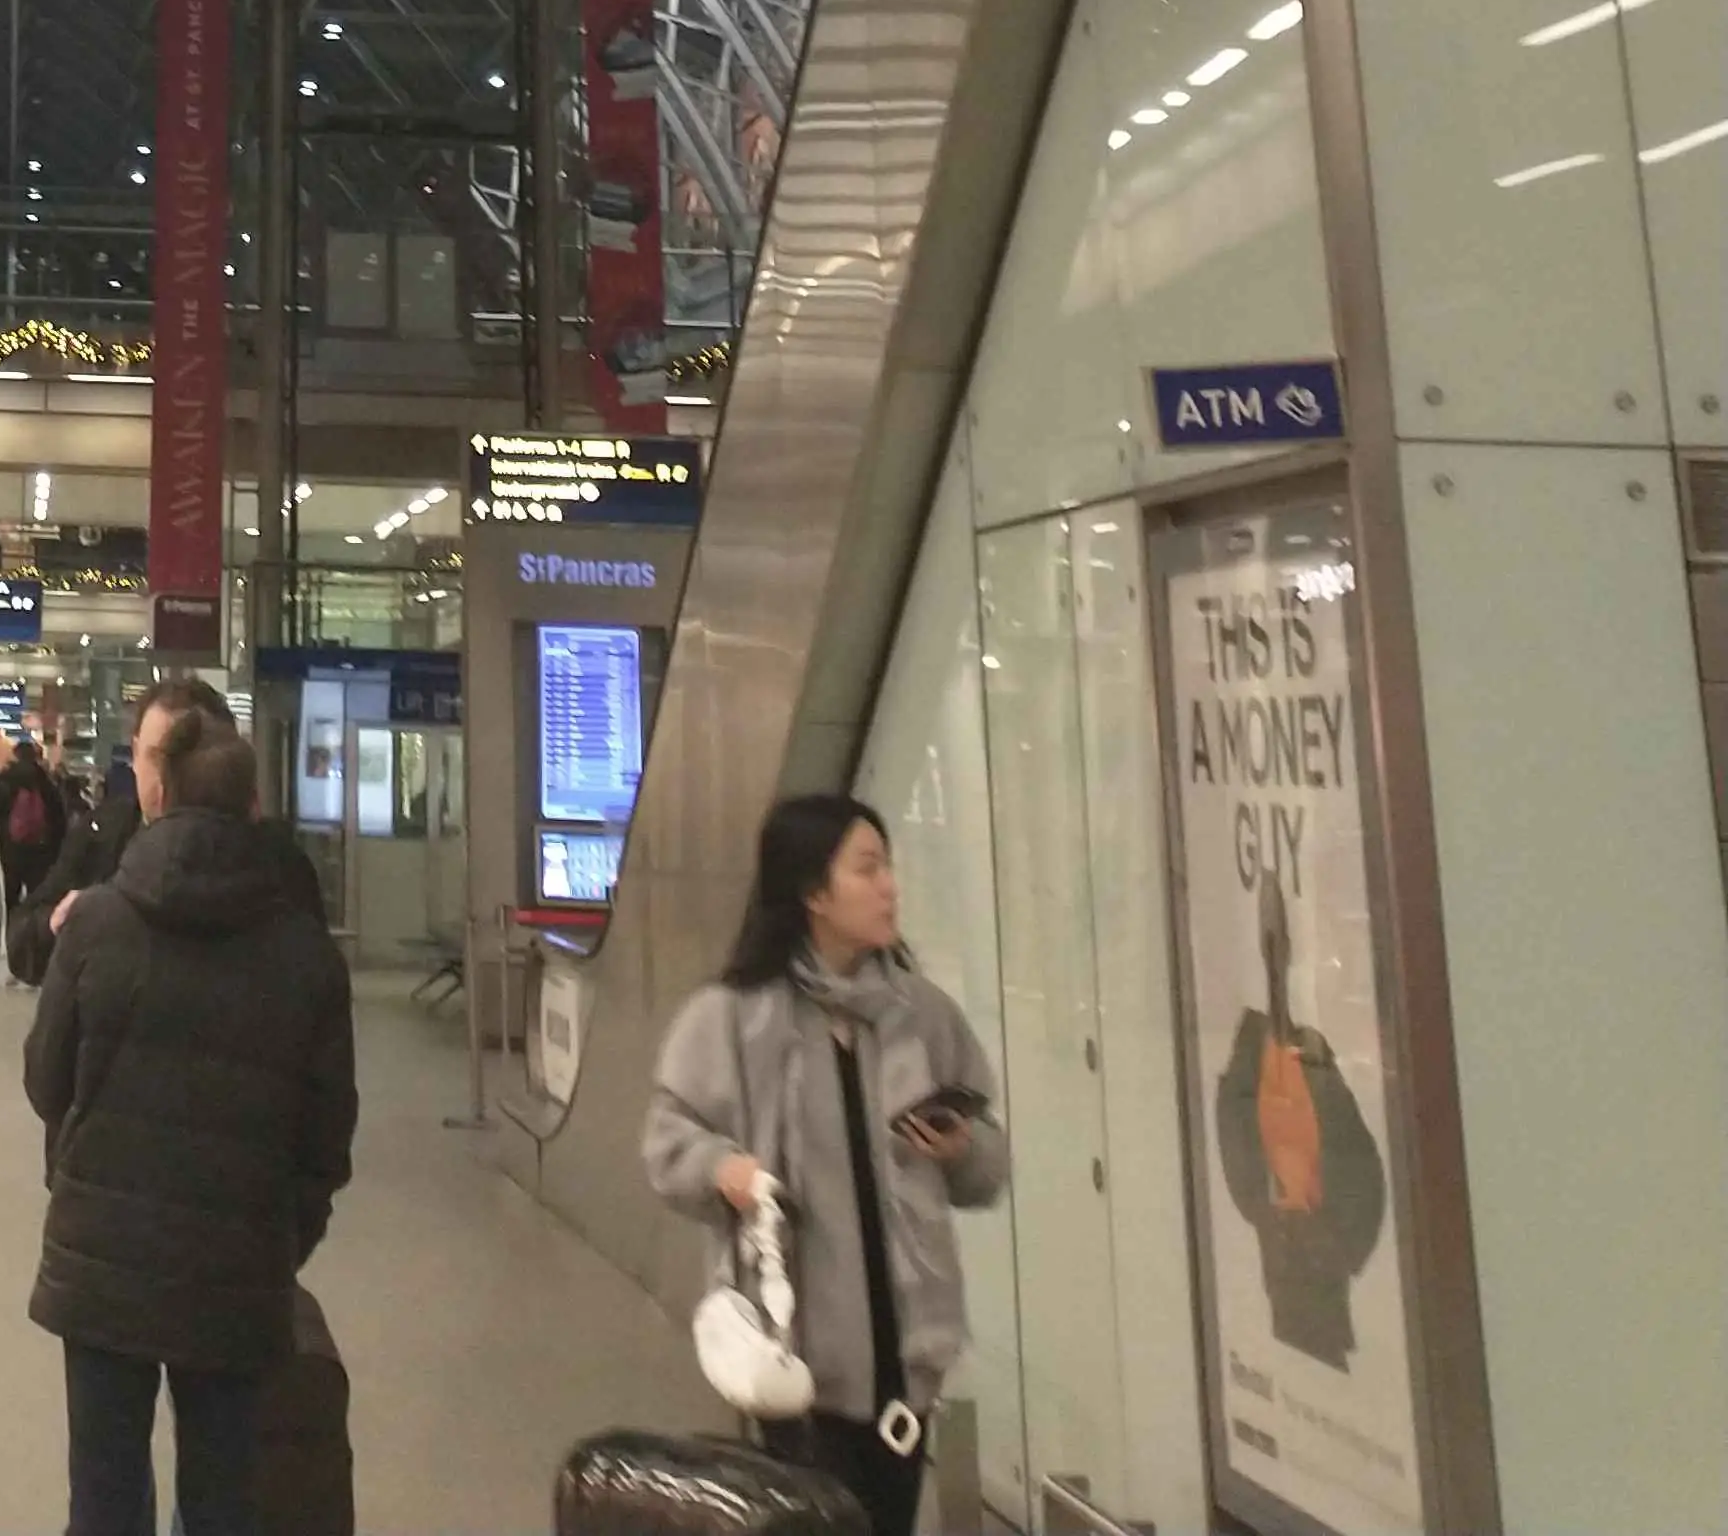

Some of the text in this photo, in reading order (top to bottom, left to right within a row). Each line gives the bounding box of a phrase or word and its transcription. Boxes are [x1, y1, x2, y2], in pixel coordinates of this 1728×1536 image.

[182, 298, 199, 341] THE
[1176, 386, 1265, 431] ATM
[1196, 585, 1317, 683] THIS IS
[1192, 693, 1343, 790] A MONEY
[1236, 800, 1306, 898] GUY
